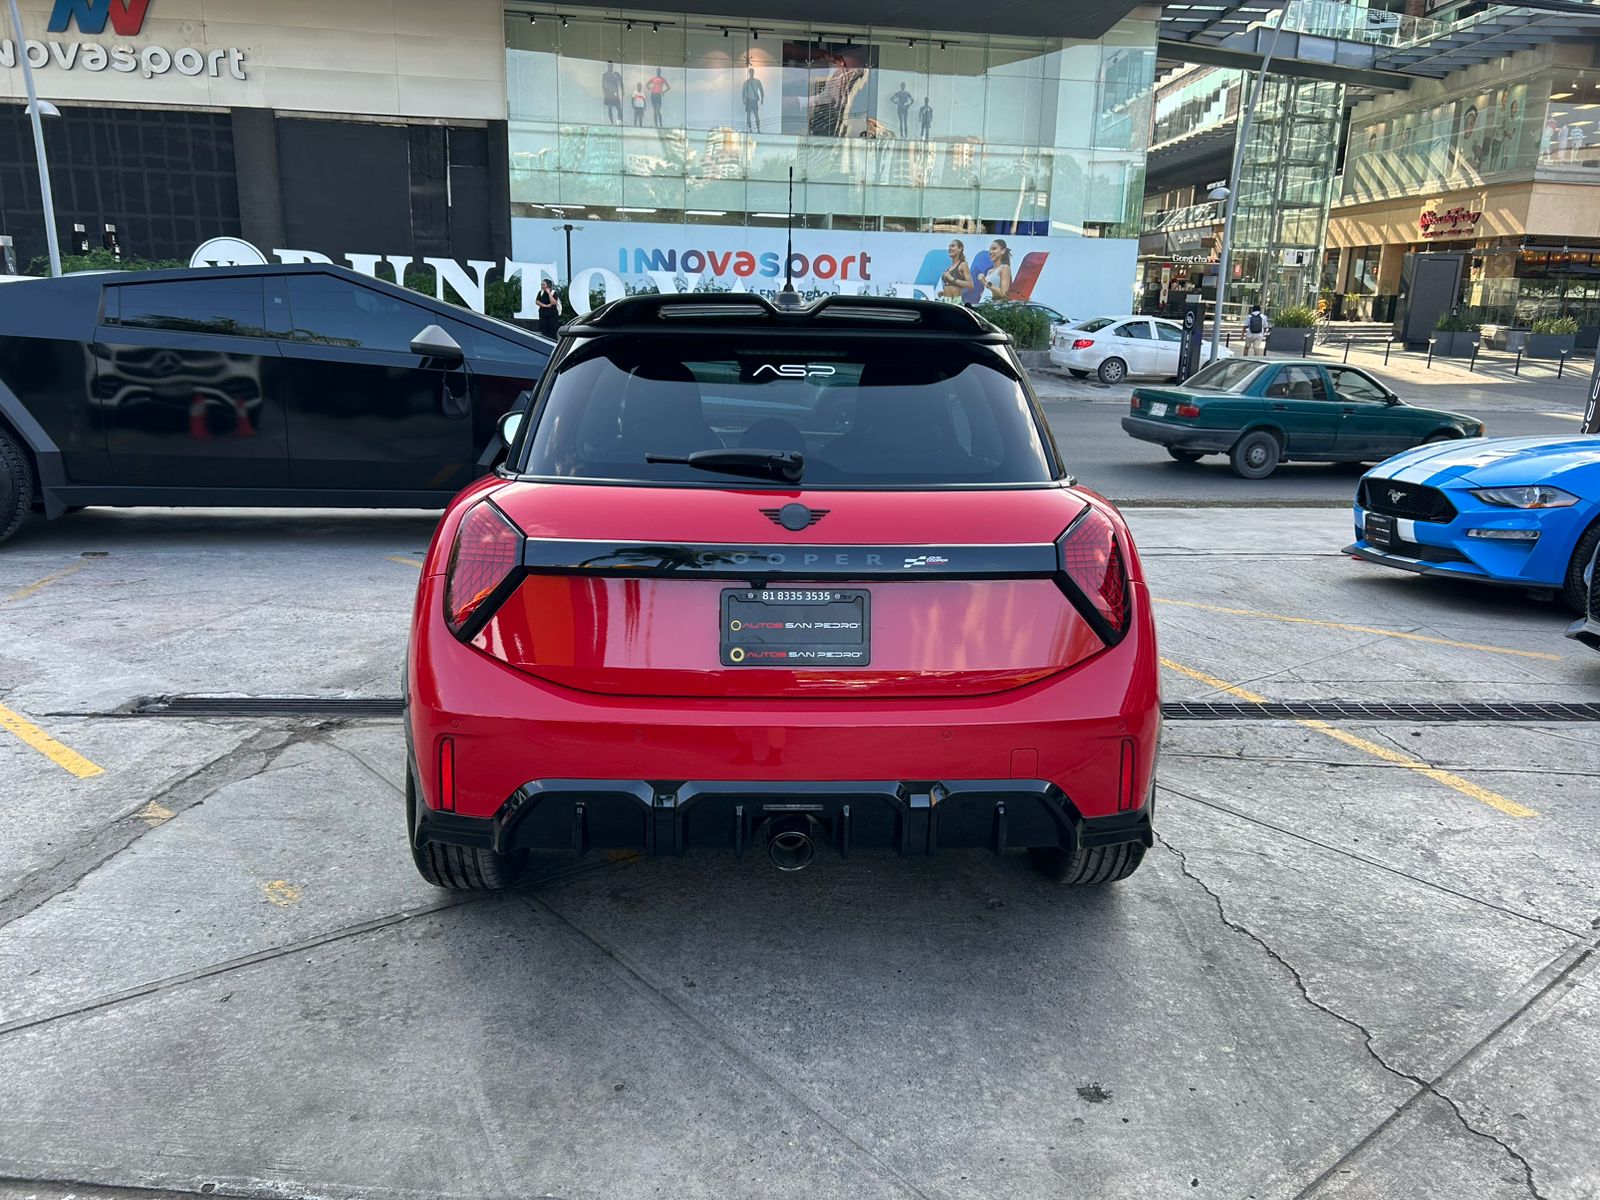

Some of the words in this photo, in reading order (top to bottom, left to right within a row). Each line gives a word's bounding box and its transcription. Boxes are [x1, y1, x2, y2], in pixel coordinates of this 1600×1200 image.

[1172, 253, 1194, 264] Gong
[1193, 254, 1207, 263] cha
[272, 247, 627, 321] NTO
[697, 552, 882, 566] COOPER
[762, 591, 775, 600] 81
[777, 591, 803, 601] 8335
[805, 592, 831, 601] 3535
